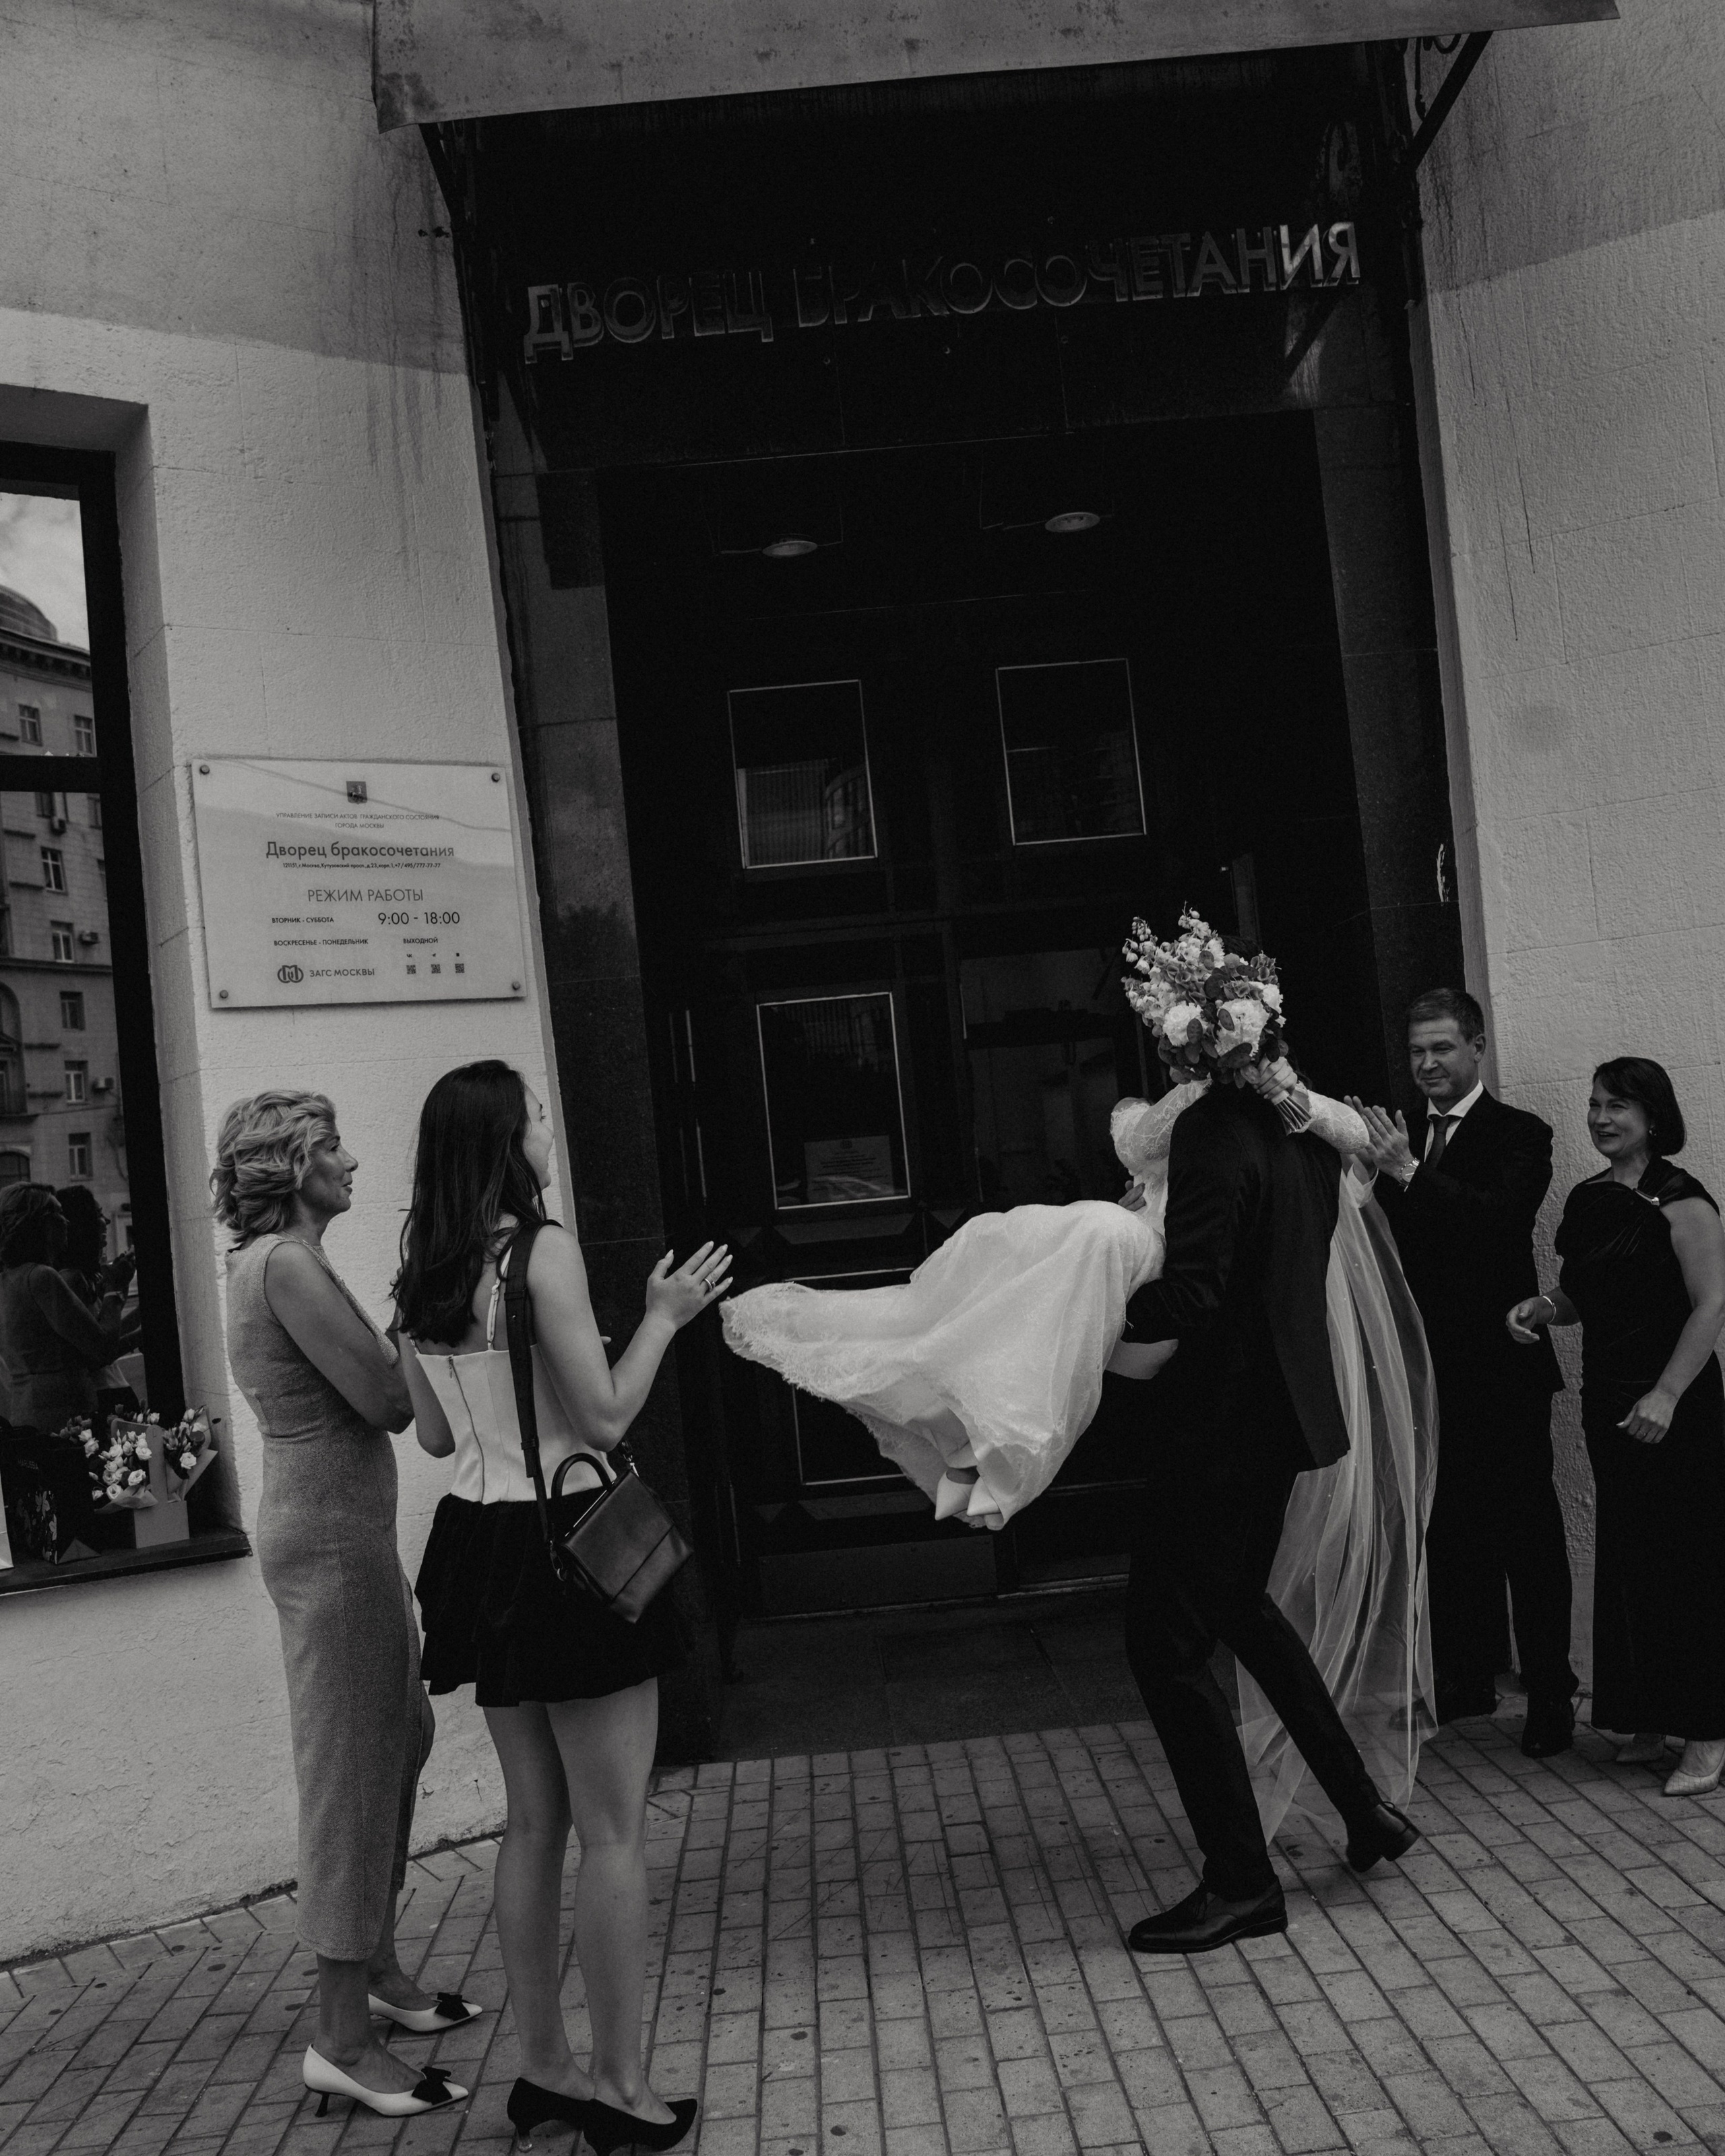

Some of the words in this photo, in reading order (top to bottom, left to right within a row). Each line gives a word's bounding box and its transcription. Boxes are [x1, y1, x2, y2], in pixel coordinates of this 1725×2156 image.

[523, 270, 774, 364] ДВОРЕЦ
[793, 221, 1360, 328] БРАКОСОЧЕТАНИЯ
[265, 842, 327, 860] Дворец
[330, 841, 454, 860] бракосочетания
[307, 889, 363, 902] РЕЖИМ
[368, 889, 424, 901] РАБОТЫ
[377, 912, 409, 925] 9:00
[424, 911, 460, 924] 18:00
[322, 938, 369, 946] ПОНЕДЕЛЬНИК
[403, 937, 438, 945] ВЫХОДНОЙ
[334, 969, 375, 977] МОСКВЫ
